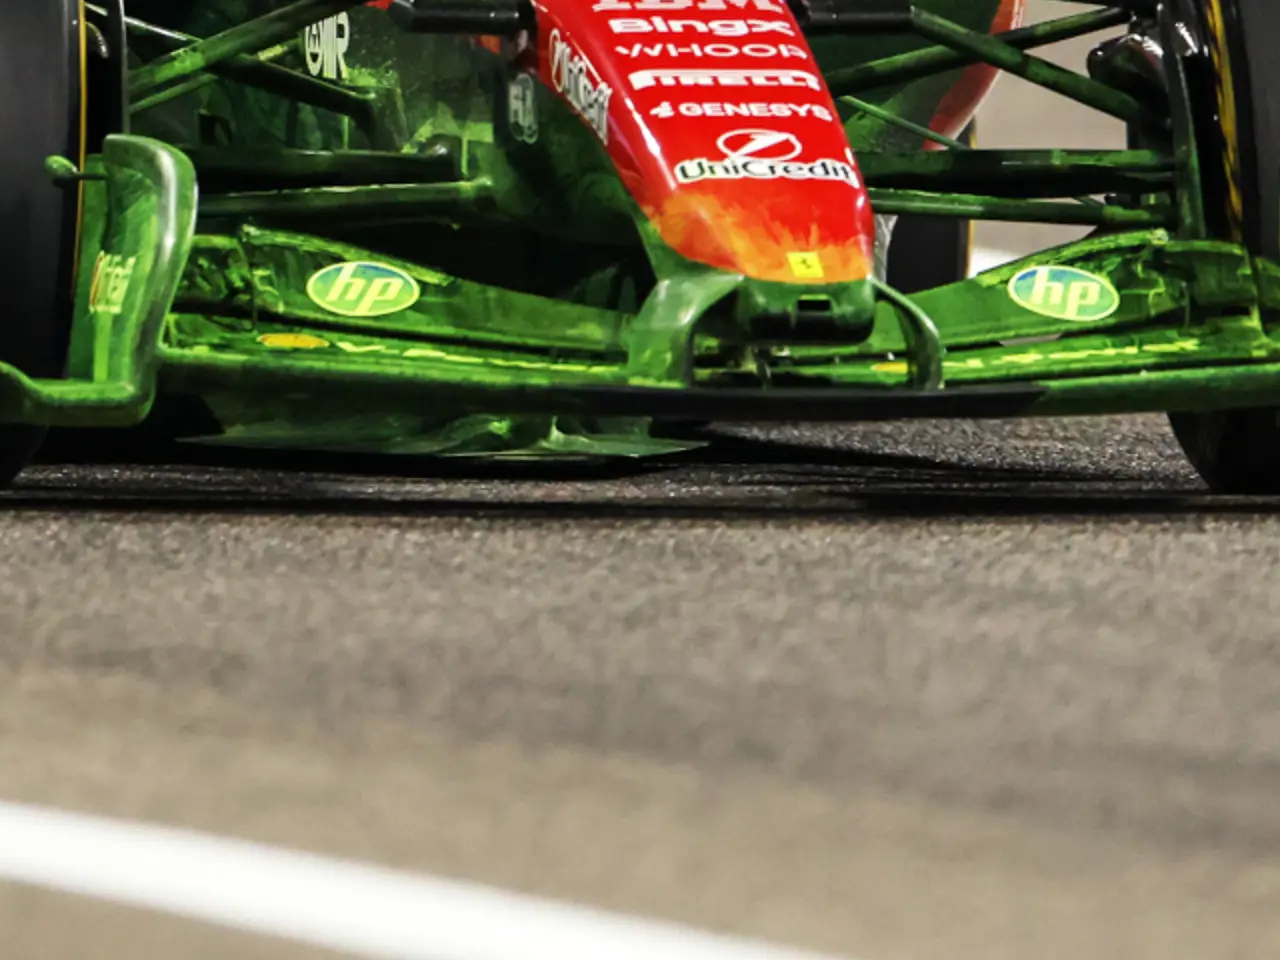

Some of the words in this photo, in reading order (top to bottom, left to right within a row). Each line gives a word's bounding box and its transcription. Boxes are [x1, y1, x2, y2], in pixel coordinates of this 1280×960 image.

[615, 43, 808, 59] WHOOP
[628, 67, 821, 91] PIRELLI
[678, 102, 833, 122] GENESYS
[677, 159, 860, 183] UniCredit
[324, 263, 410, 316] hp
[1030, 267, 1102, 321] hp
